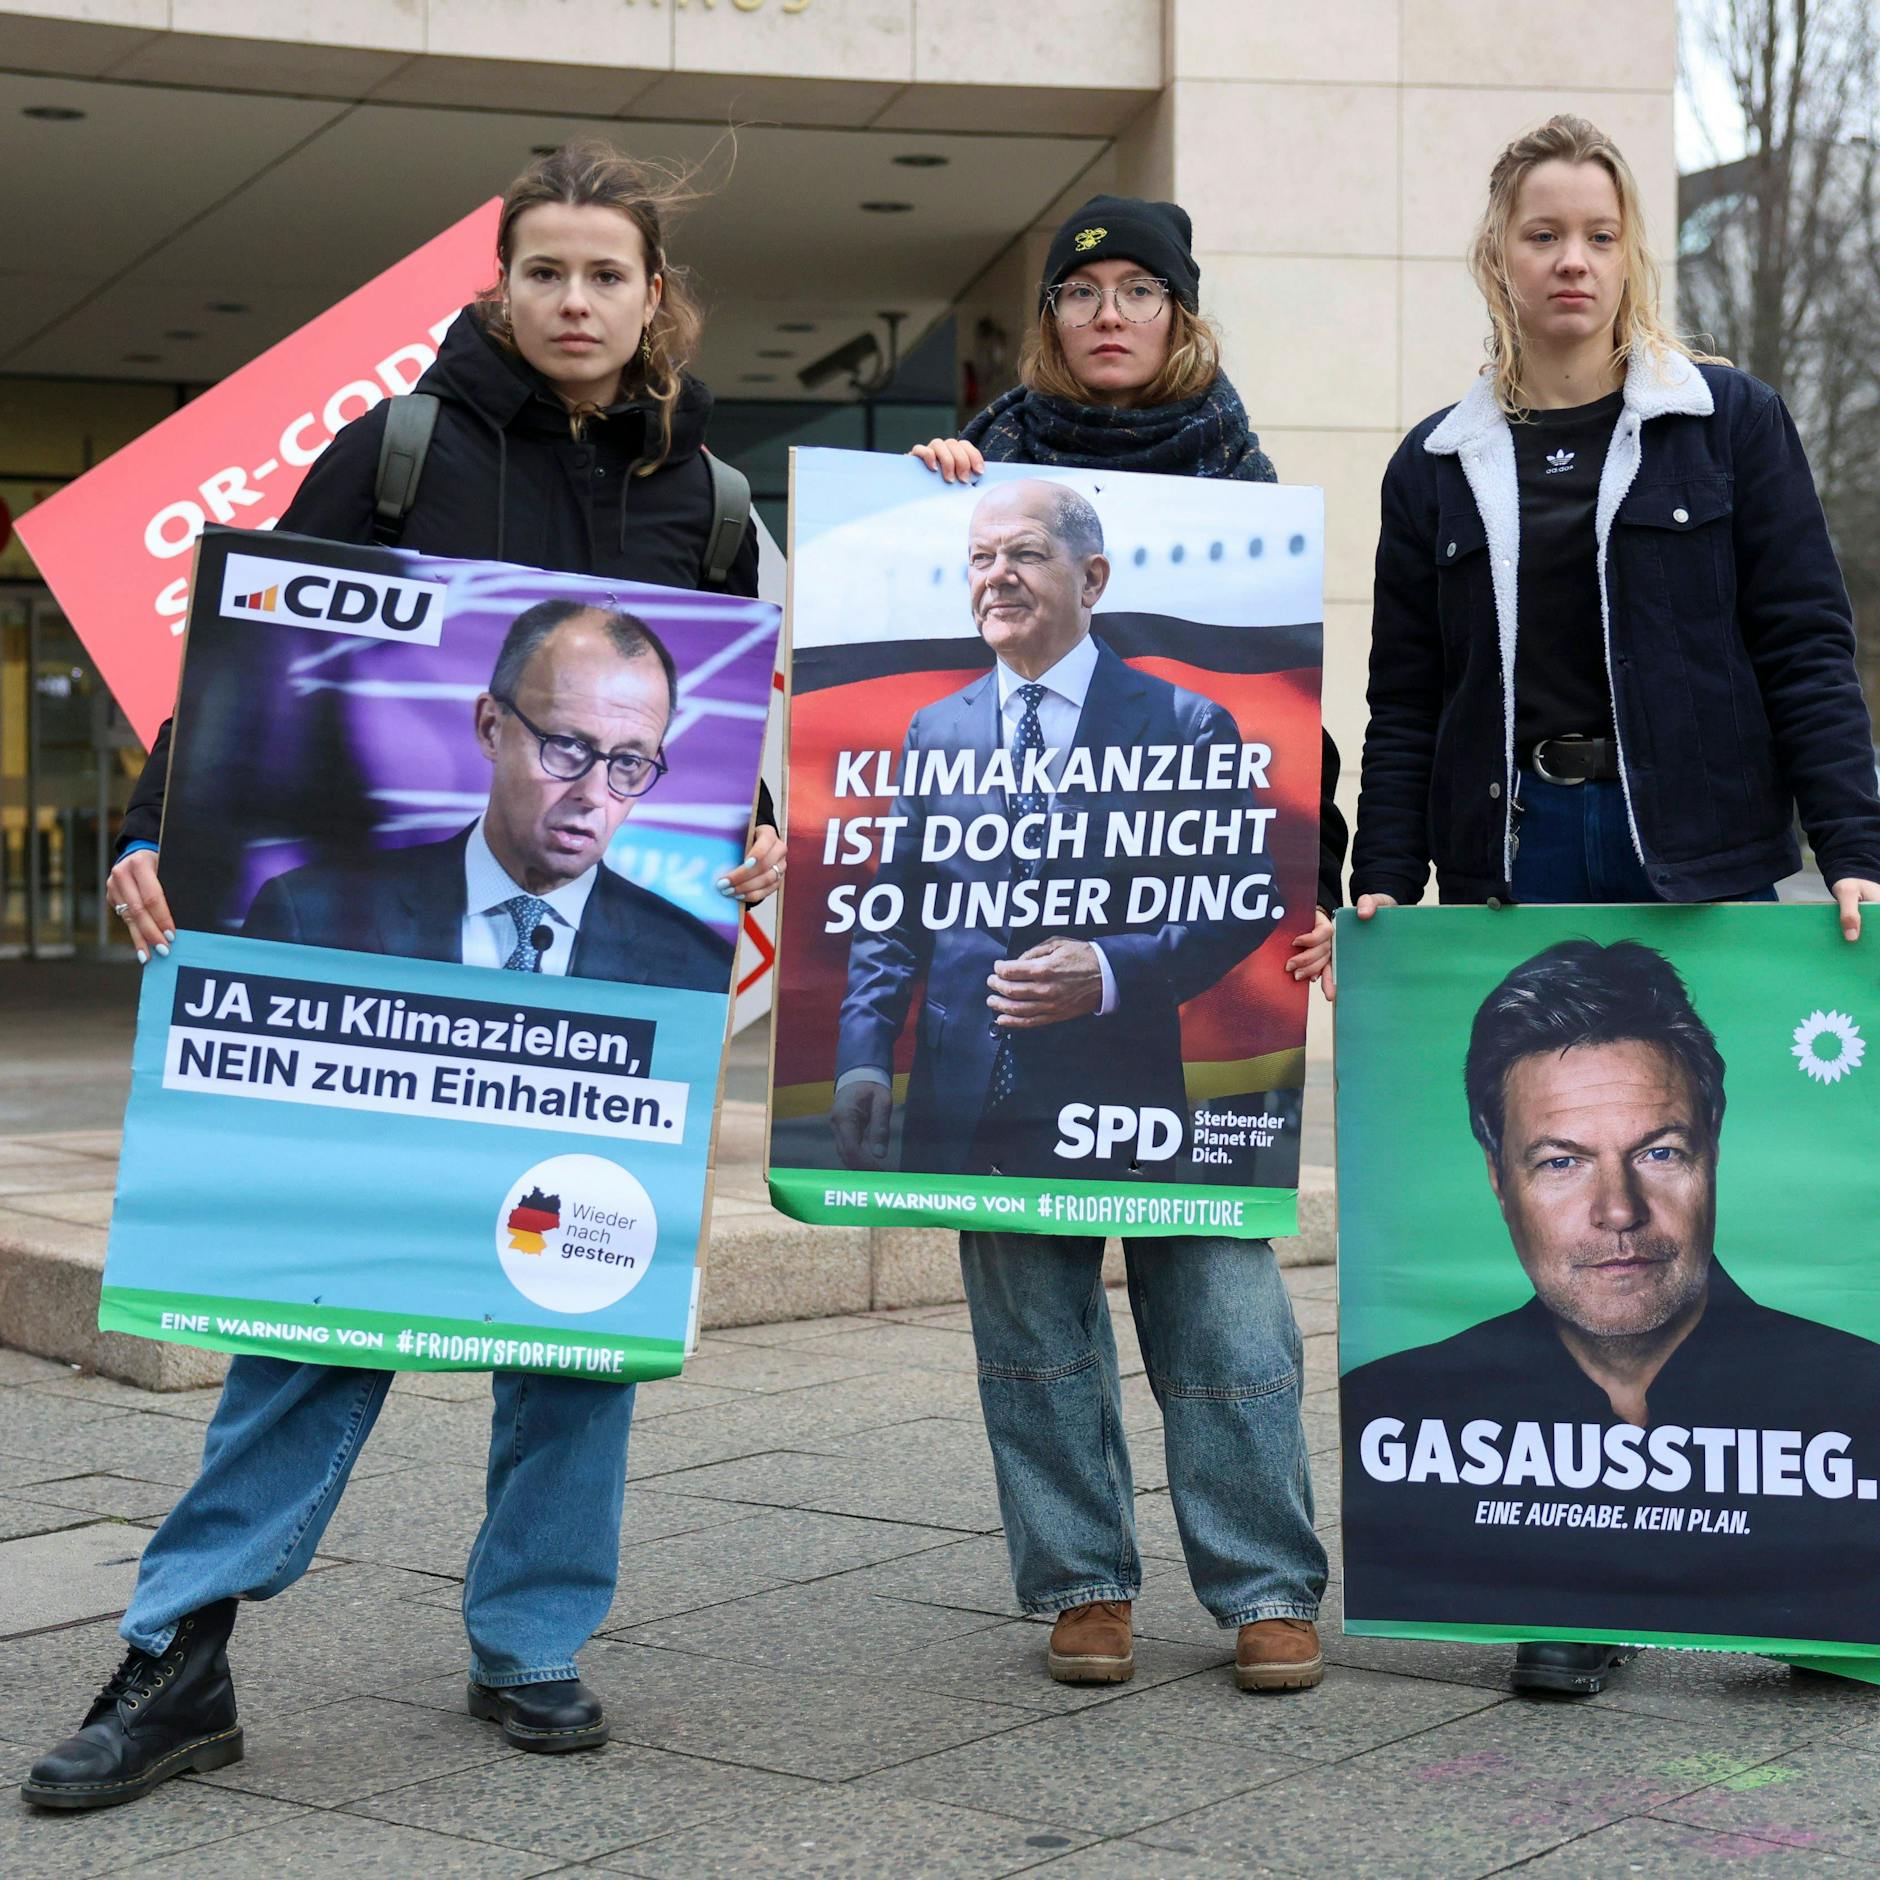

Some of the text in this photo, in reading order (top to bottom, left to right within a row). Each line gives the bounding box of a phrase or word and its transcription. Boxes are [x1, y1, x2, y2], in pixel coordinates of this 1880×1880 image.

[284, 575, 432, 631] CDU
[834, 743, 1272, 797] KLIMAKANZLER
[823, 808, 1277, 865] IST DOCH NICHT
[825, 873, 1286, 934] SO UNSER DING.
[184, 979, 642, 1076] JA zu Klimazielen,
[178, 1038, 674, 1129] NEIN zum Einhalten.
[1053, 1102, 1183, 1161] SPD
[1194, 1110, 1285, 1129] Sterbender
[1194, 1129, 1274, 1147] Planet für
[1192, 1147, 1233, 1164] Dich.
[566, 1223, 611, 1244] nach
[572, 1202, 637, 1230] Wieder
[824, 1190, 1244, 1227] EINE WARNUNG VON #FRIDAYSFORFUTURE
[561, 1243, 635, 1269] gestern
[161, 1312, 625, 1373] EINE WARNUNG VON #FRIDAYSFORFUTURE
[1360, 1417, 1878, 1499] GASAUSSTIEG.
[1475, 1500, 1751, 1535] EINE AUFGABE. KEIN PLAN.
